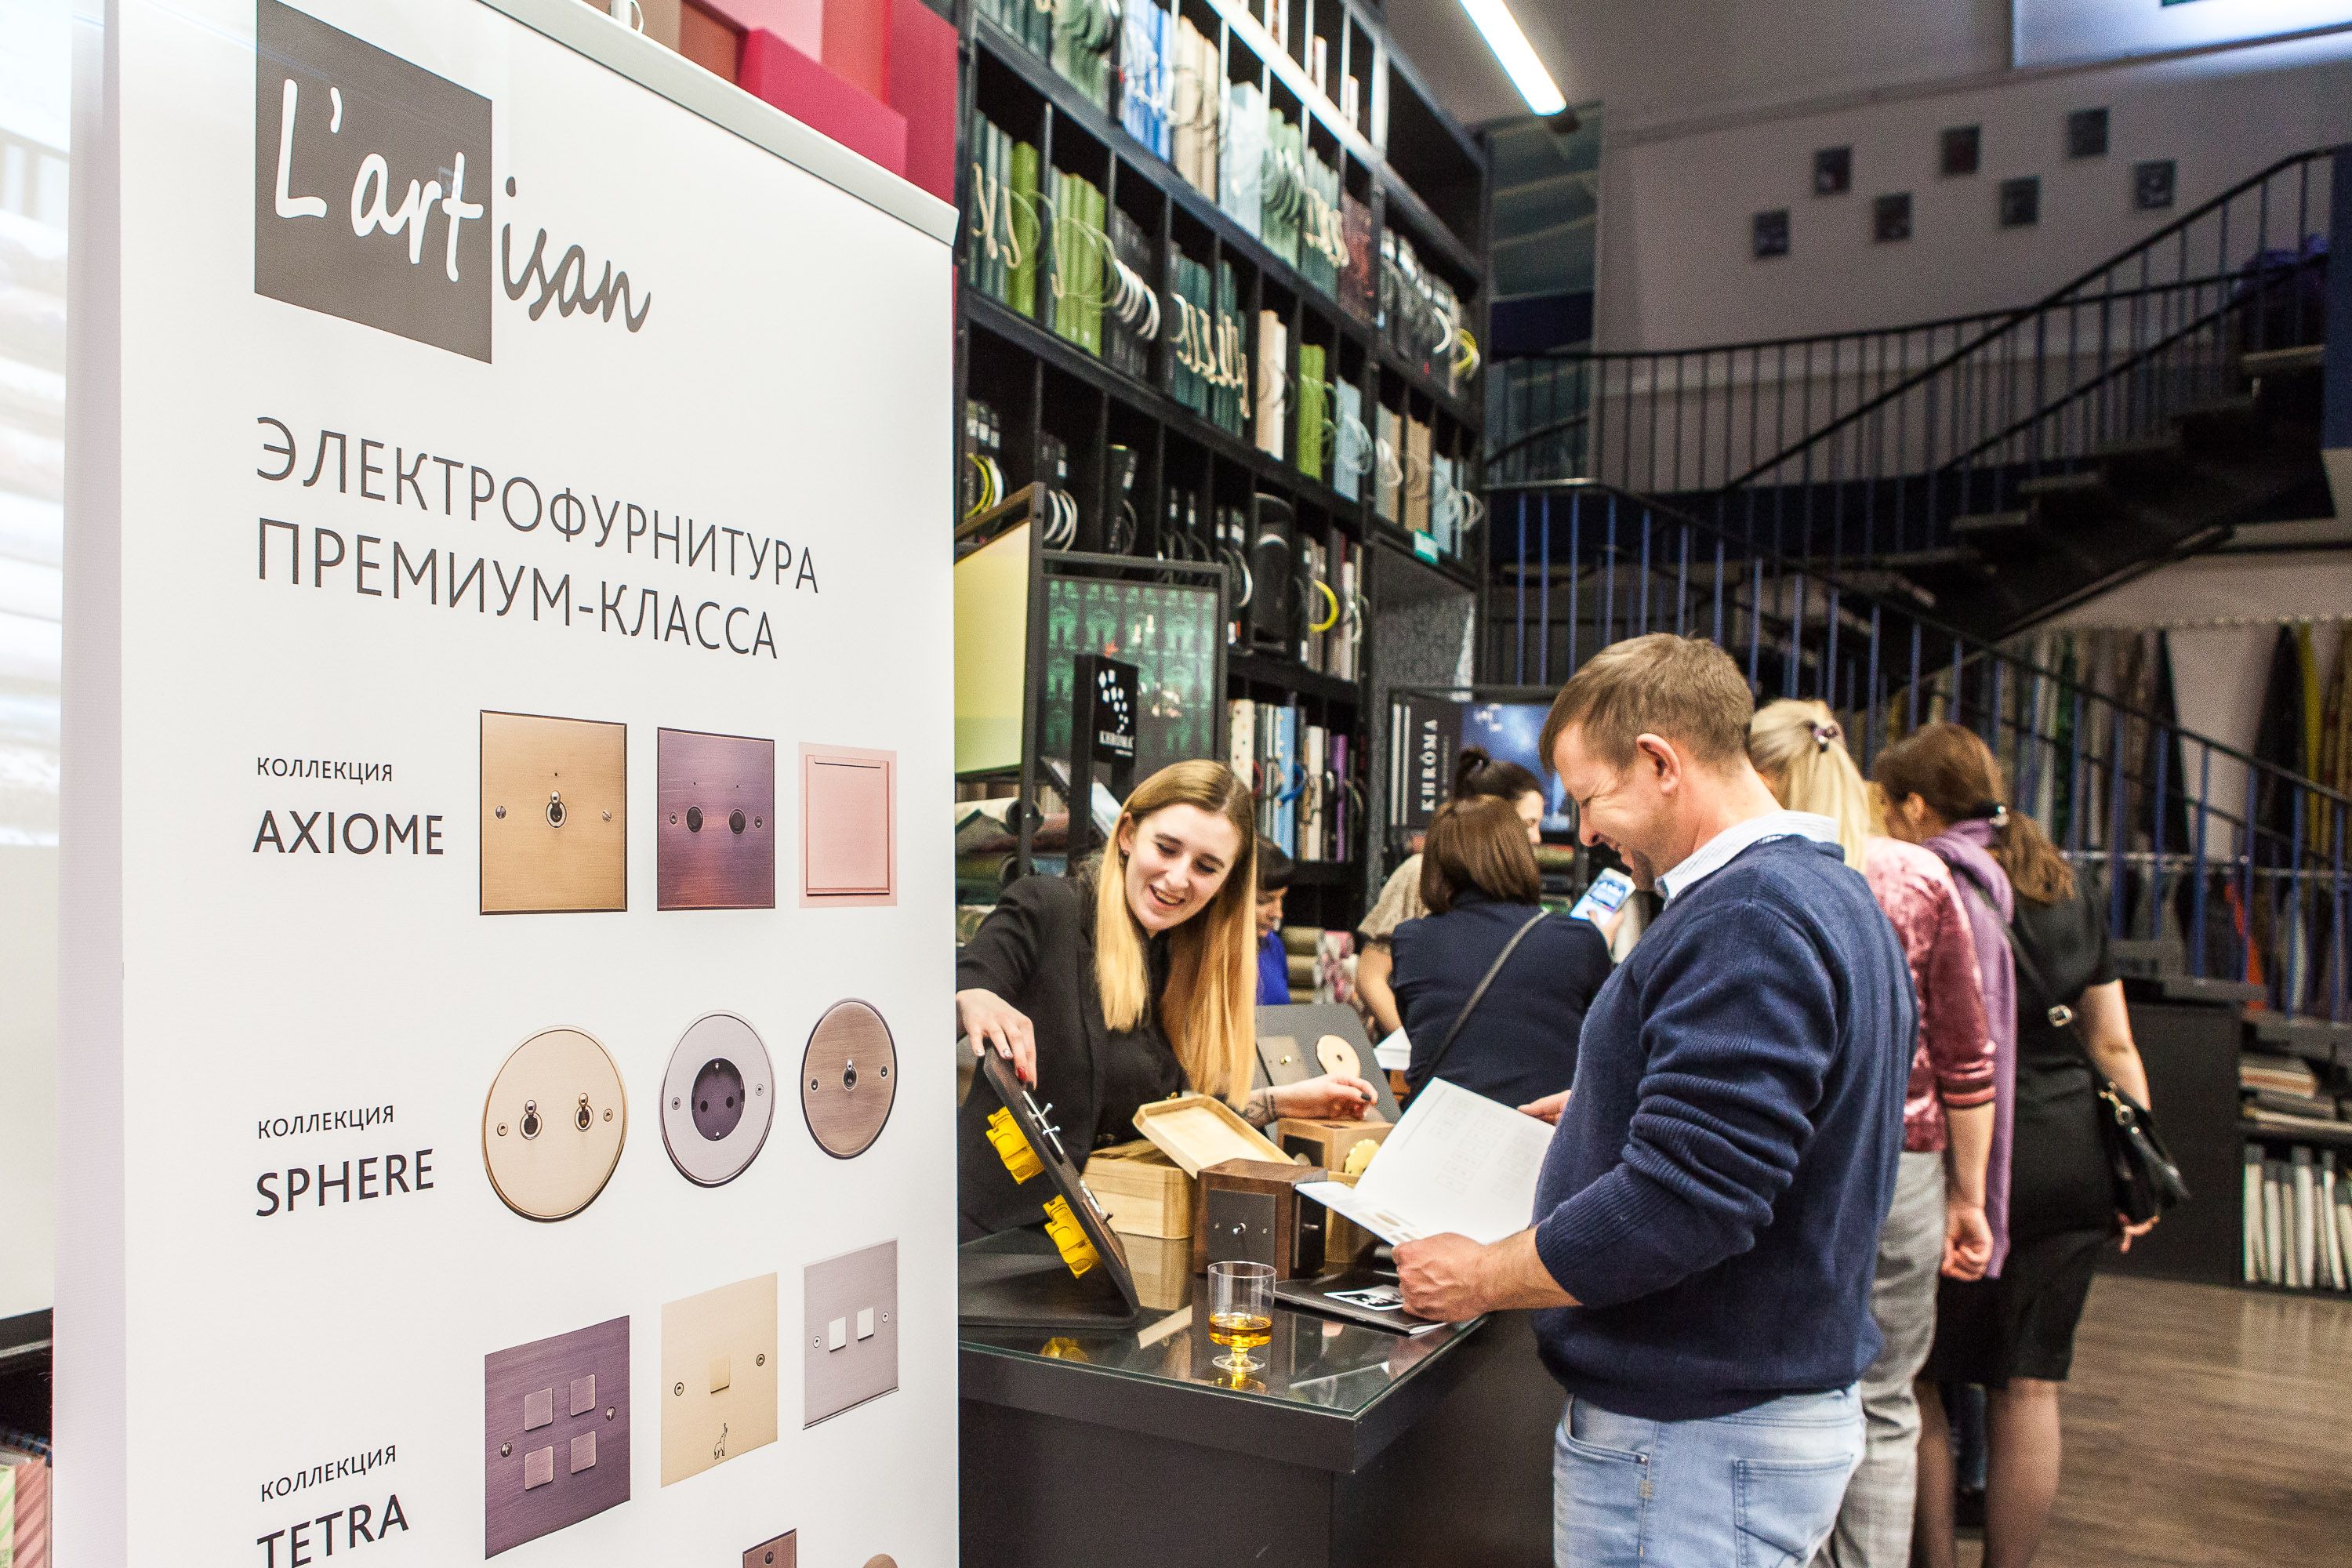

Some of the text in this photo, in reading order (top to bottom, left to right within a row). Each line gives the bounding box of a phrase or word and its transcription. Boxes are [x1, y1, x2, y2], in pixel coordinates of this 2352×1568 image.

[275, 78, 651, 332] L'artisan
[257, 417, 818, 593] ЭЛЕКТРОФУРНИТУРА
[260, 518, 777, 659] ПРЕМИУМ-КЛАССА
[257, 757, 392, 785] КОЛЛЕКЦИЯ
[252, 810, 444, 855] AXIOME
[258, 1105, 394, 1139] КОЛЛЕКЦИЯ
[256, 1149, 434, 1217] SPHERE
[262, 1445, 396, 1502] КОЛЛЕКЦИЯ
[256, 1494, 409, 1568] TETRA
